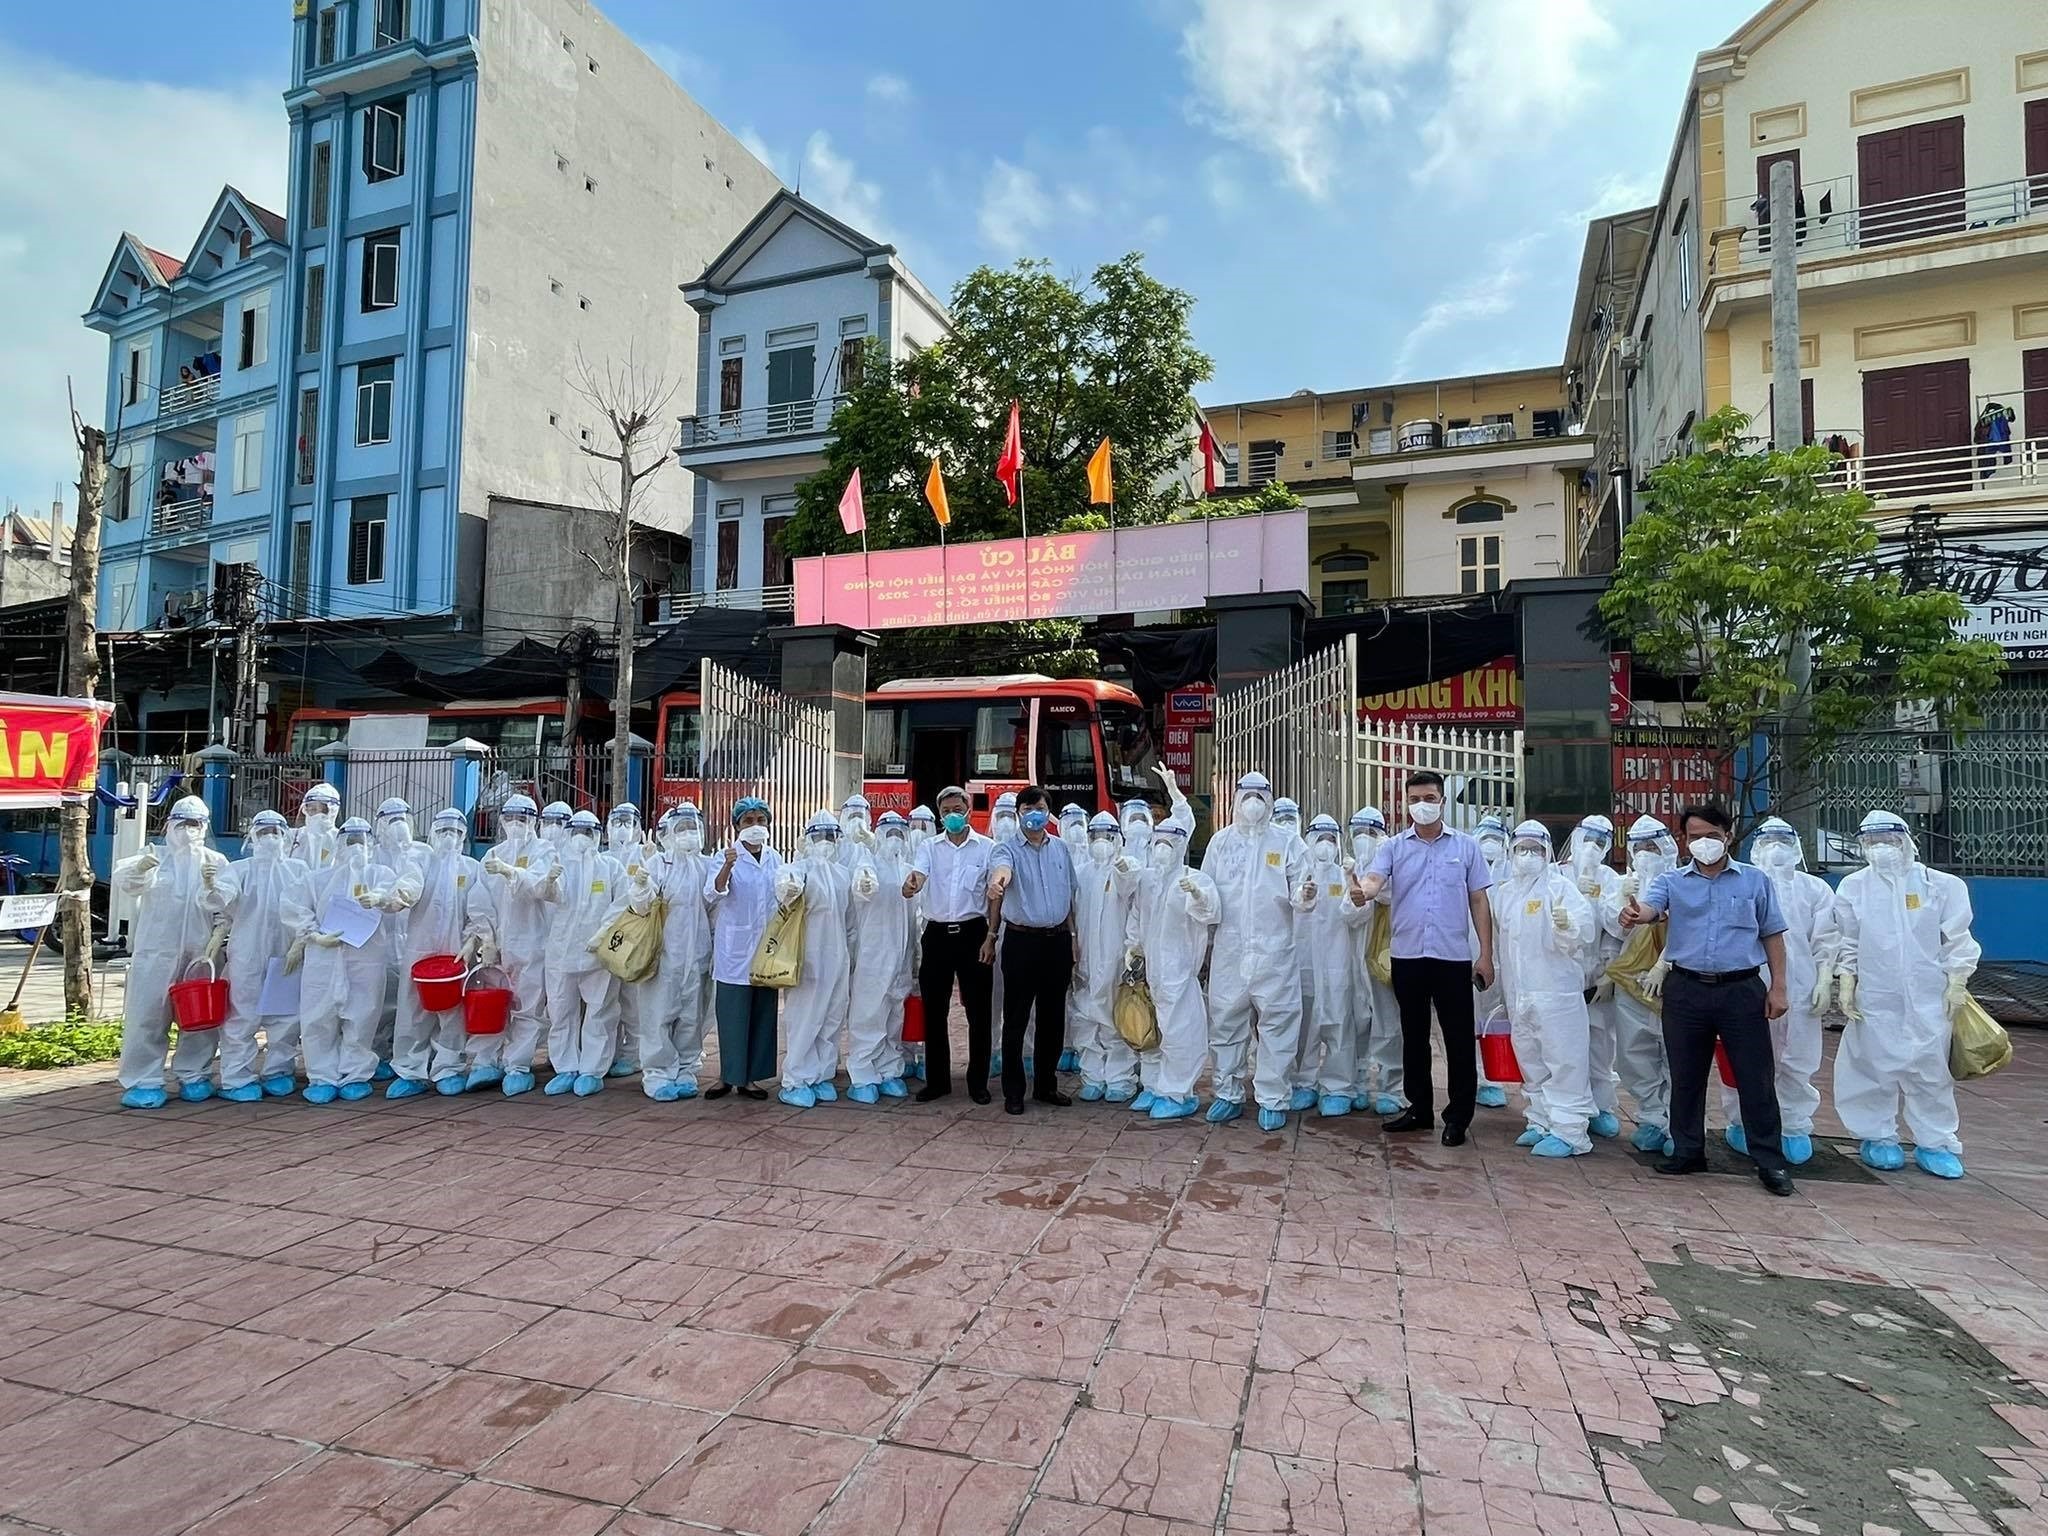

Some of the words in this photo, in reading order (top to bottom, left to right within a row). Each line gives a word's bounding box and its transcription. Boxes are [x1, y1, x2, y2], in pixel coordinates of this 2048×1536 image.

[1174, 698, 1202, 708] vivo
[1168, 728, 1189, 748] ĐIỆN
[1166, 751, 1191, 768] THOẠI
[1624, 753, 1663, 781] RÚT
